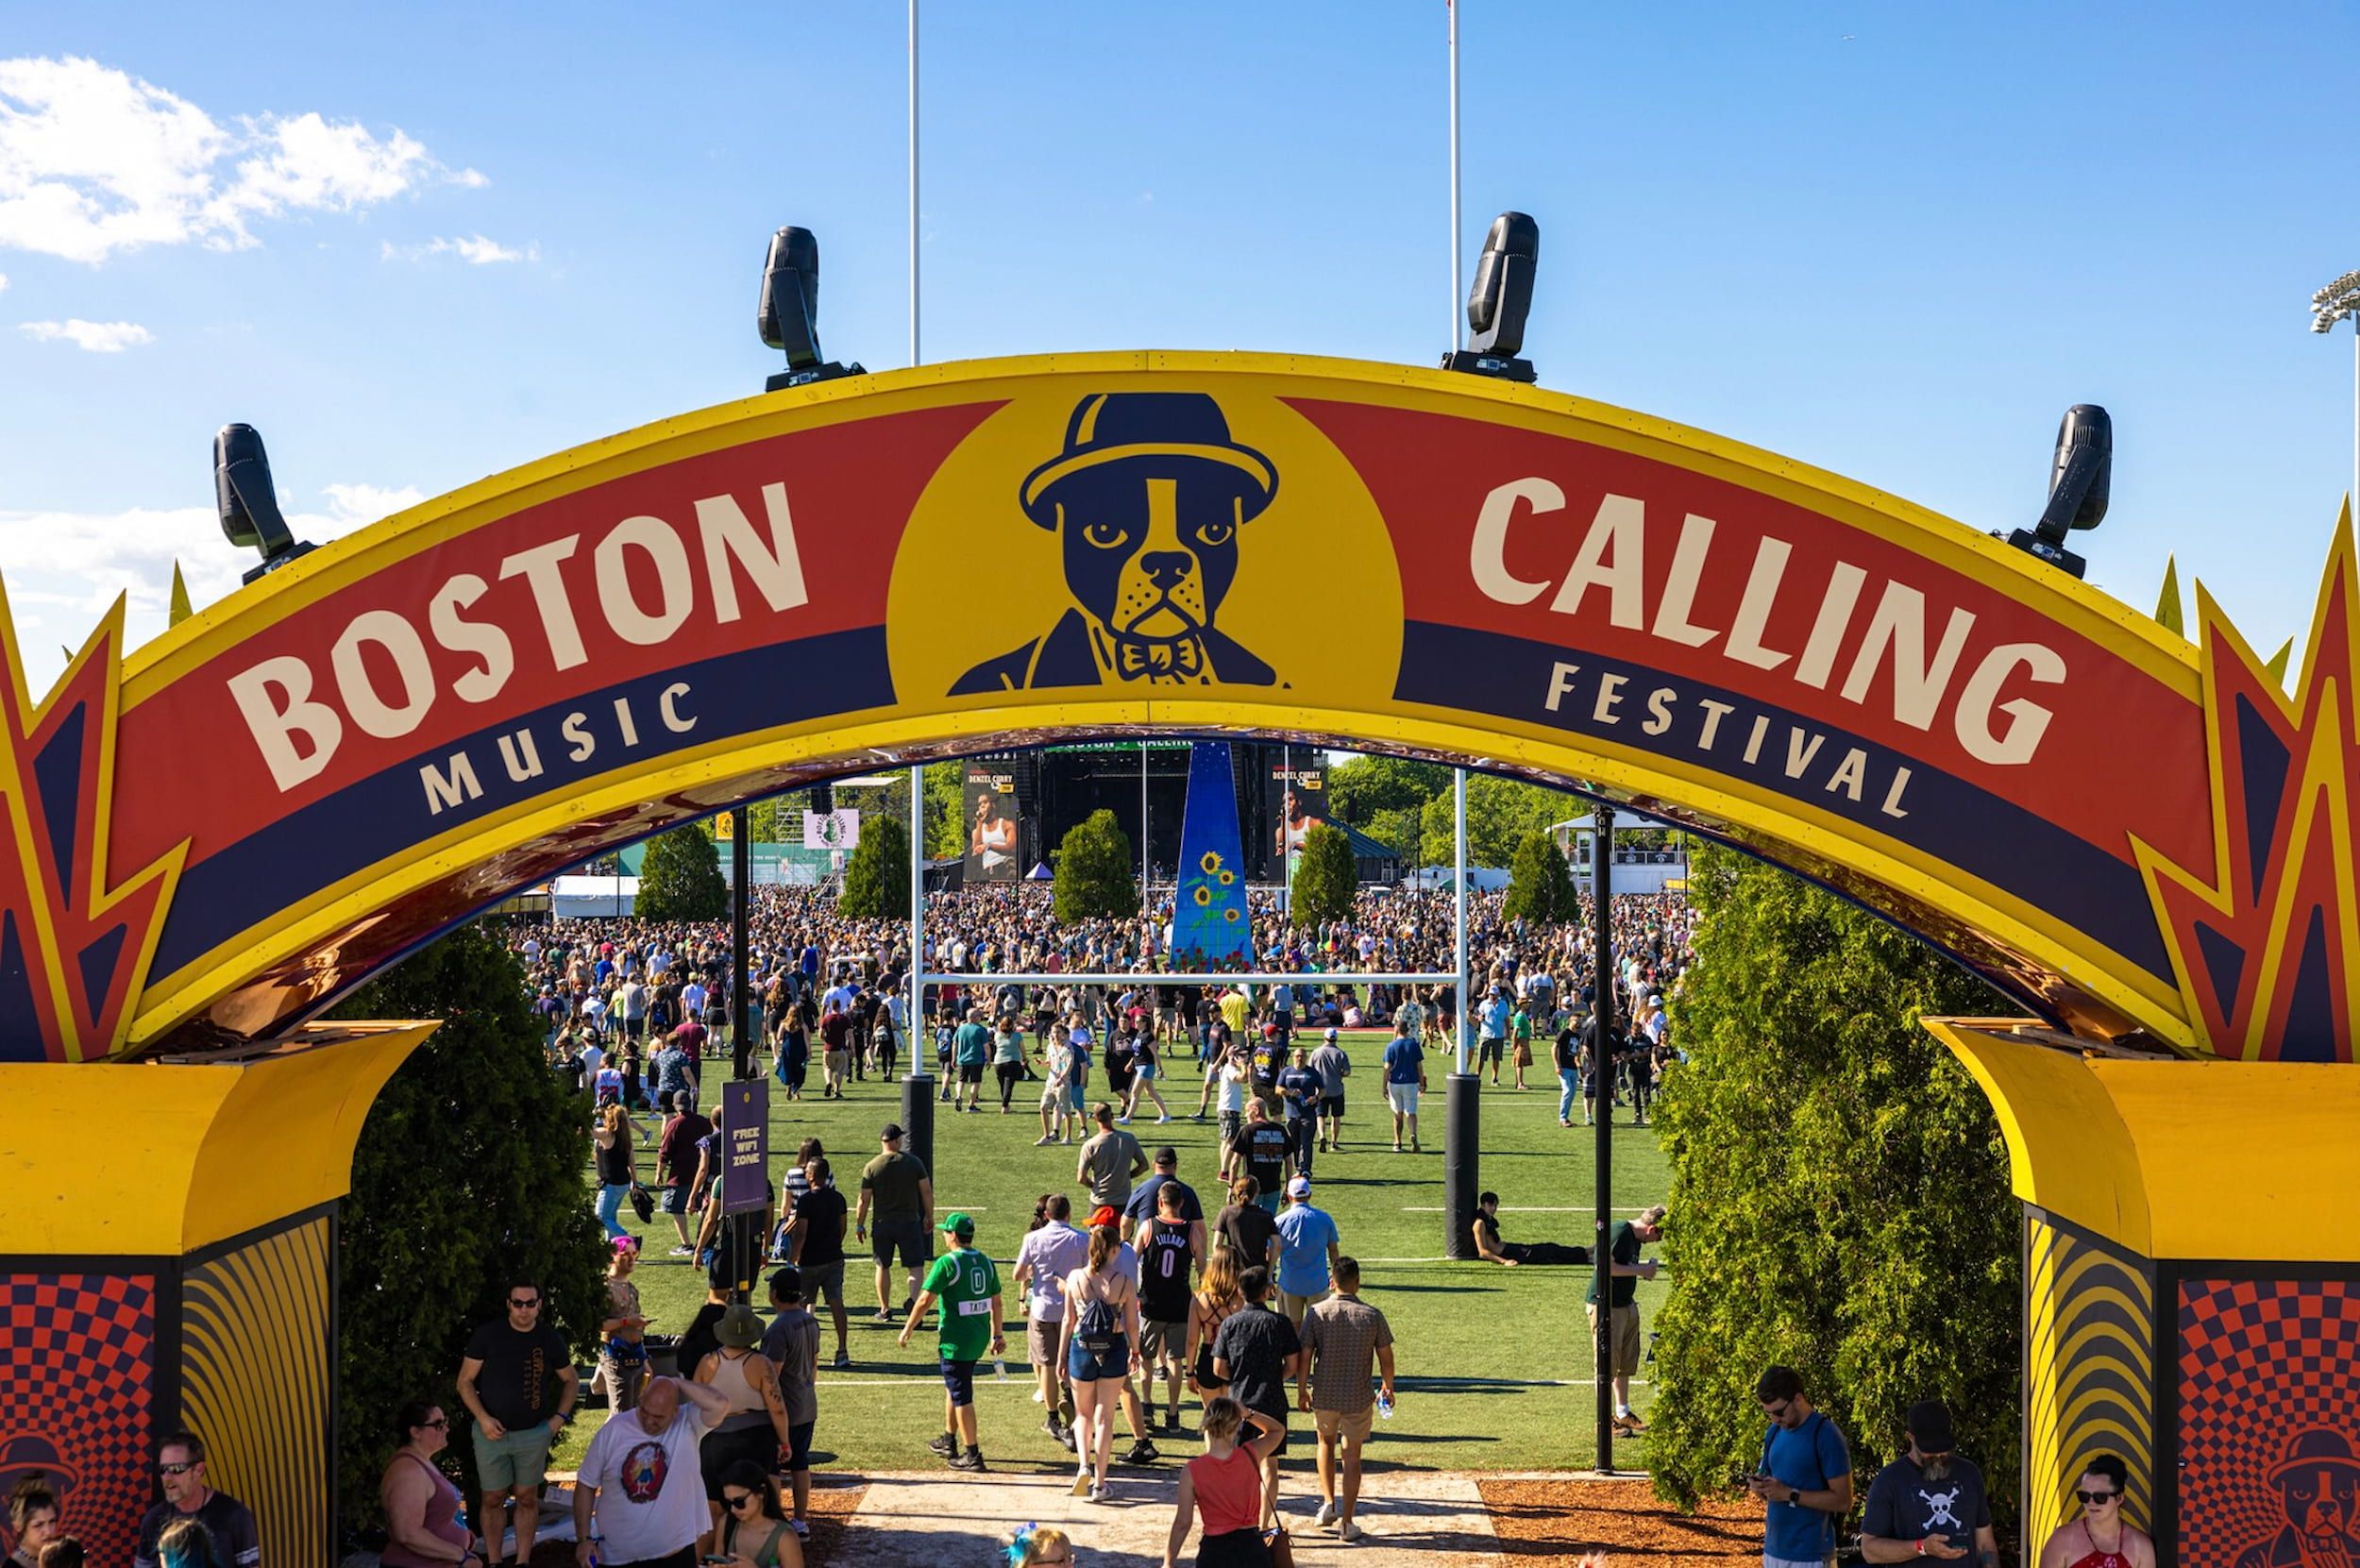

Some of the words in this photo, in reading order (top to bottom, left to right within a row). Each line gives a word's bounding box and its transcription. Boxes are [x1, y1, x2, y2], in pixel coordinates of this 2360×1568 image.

[226, 481, 809, 793] BOSTON
[1470, 476, 2067, 767] CALLING
[419, 682, 699, 816] MUSIC
[1544, 661, 1913, 819] FESTIVAL
[1272, 770, 1297, 780] DENEL
[733, 1126, 760, 1140] FREE
[735, 1139, 758, 1153] WIFI
[733, 1153, 761, 1167] ZONE
[1161, 1248, 1176, 1278] 0
[969, 1266, 987, 1295] 0
